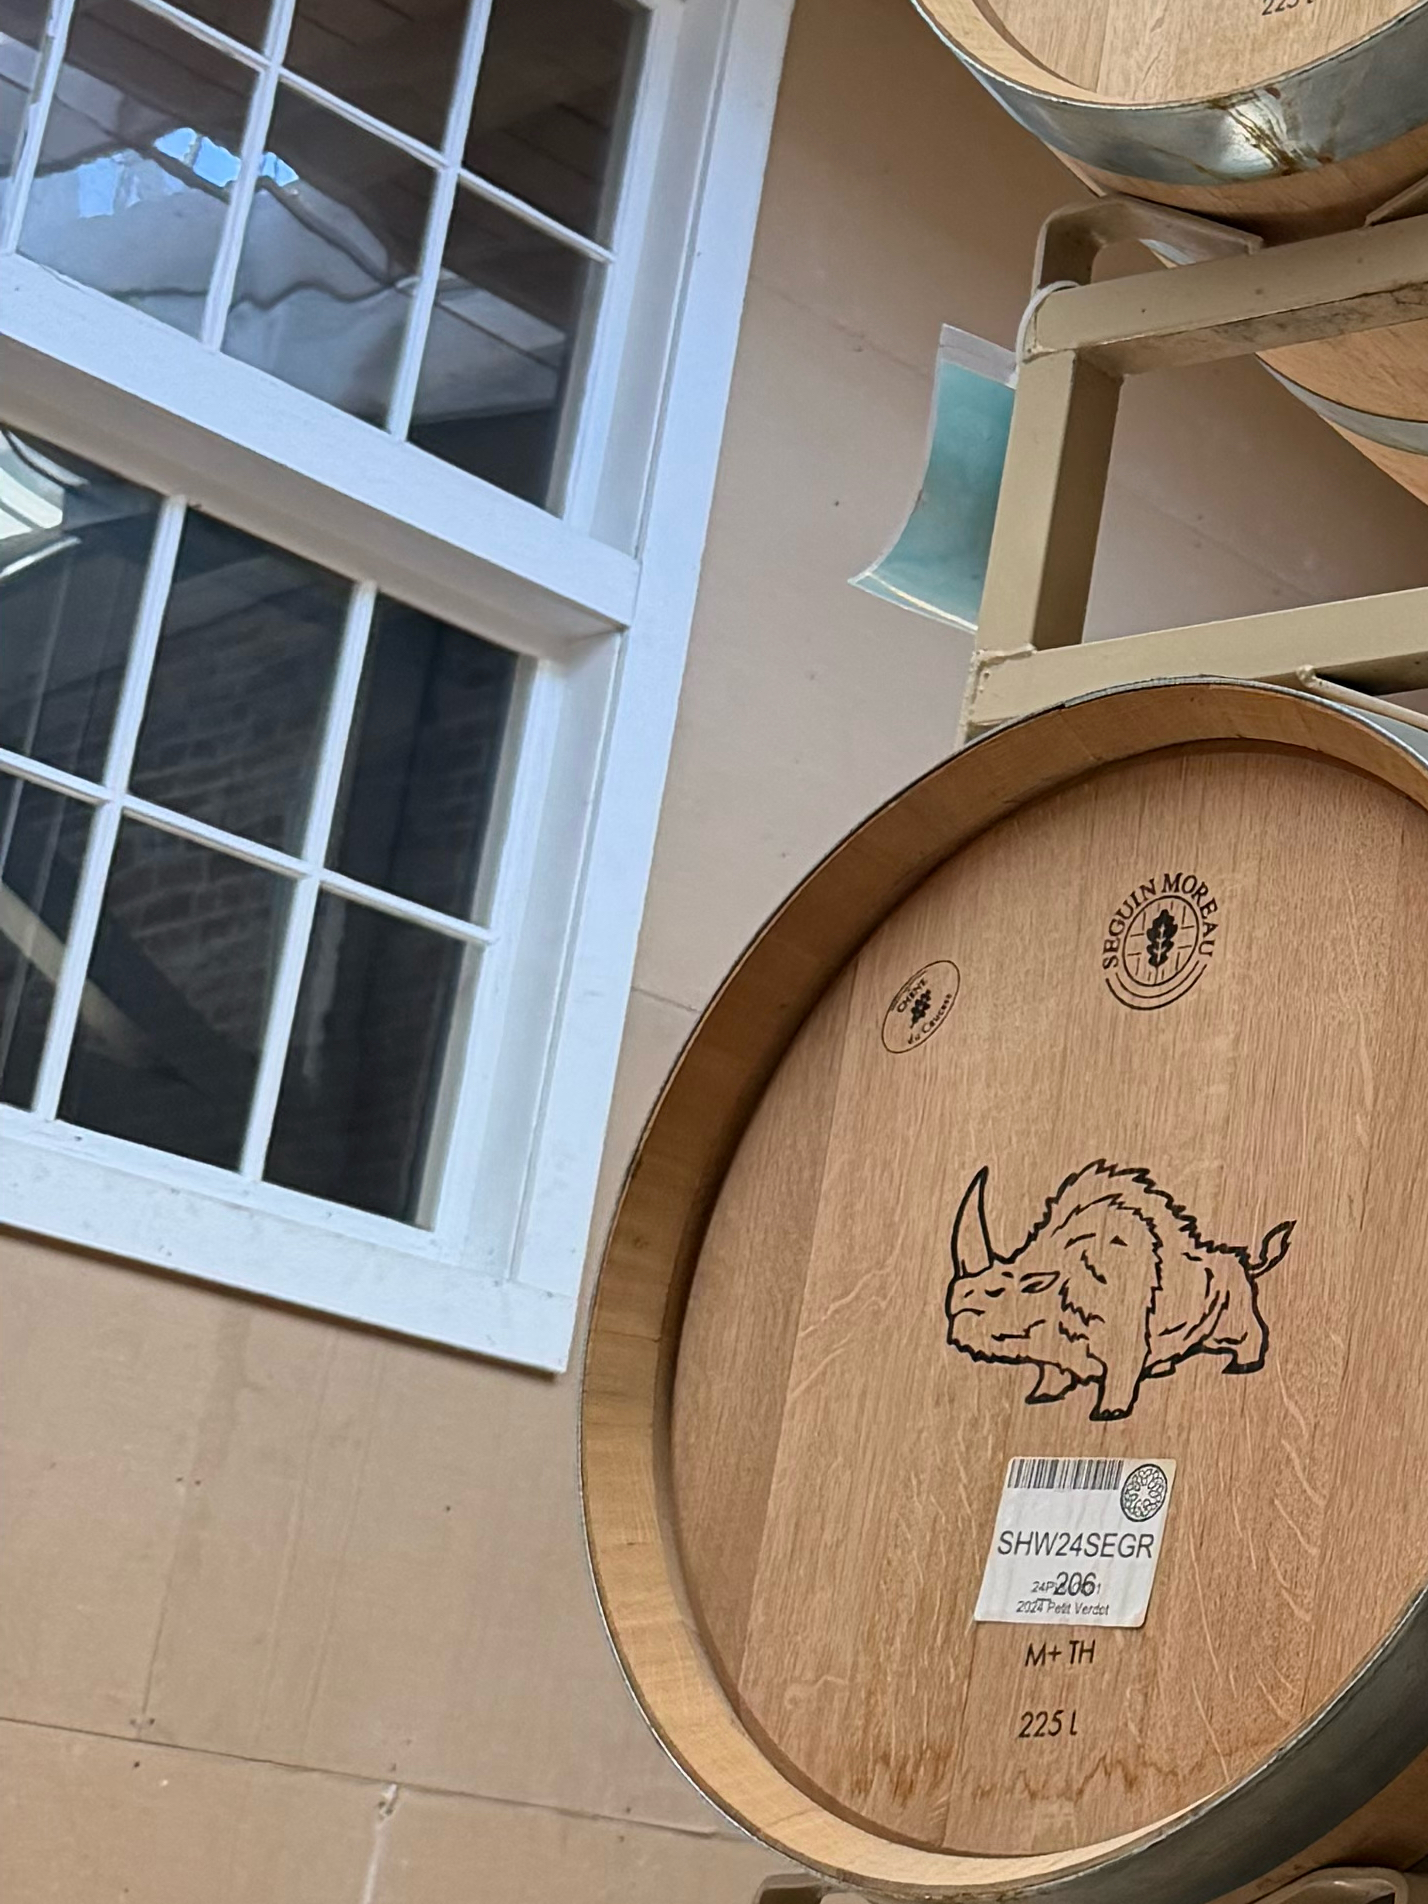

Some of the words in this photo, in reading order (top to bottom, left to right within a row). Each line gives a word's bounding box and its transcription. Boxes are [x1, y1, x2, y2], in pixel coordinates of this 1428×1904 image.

[1102, 877, 1157, 970] SEGUIN
[1160, 872, 1219, 958] MOREAU
[997, 1529, 1155, 1559] SHW24SEGR
[1068, 1639, 1096, 1665] TH
[1018, 1709, 1064, 1738] 225
